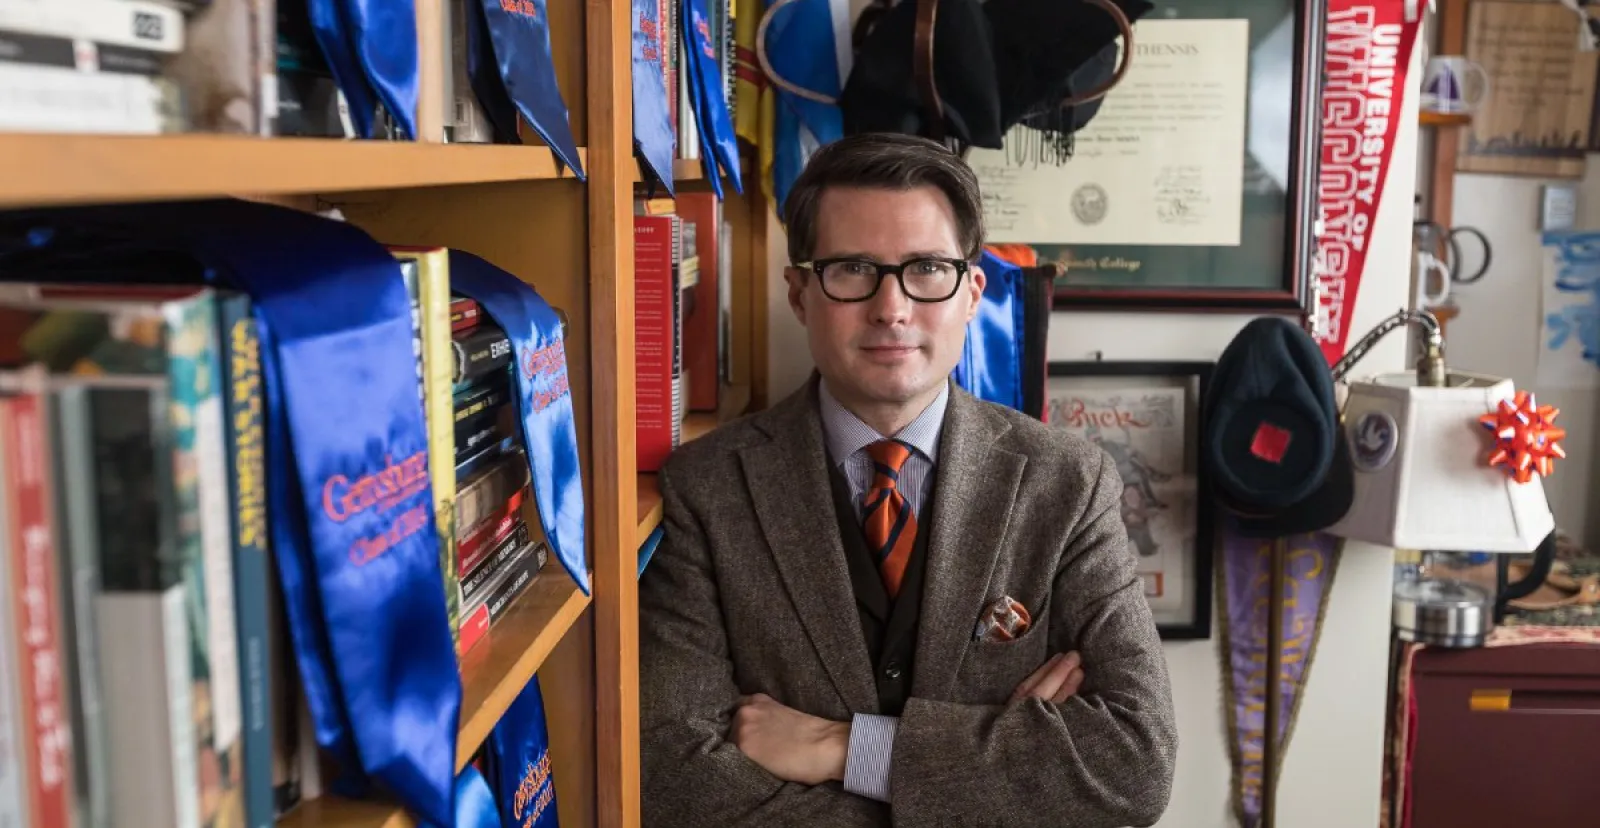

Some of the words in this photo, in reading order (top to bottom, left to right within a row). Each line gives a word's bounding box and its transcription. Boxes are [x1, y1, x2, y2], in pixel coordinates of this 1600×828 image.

[1356, 24, 1402, 205] UNIVERSITY
[1317, 6, 1376, 344] WISCONSIN
[1351, 213, 1369, 252] OF
[1060, 397, 1150, 428] Puck
